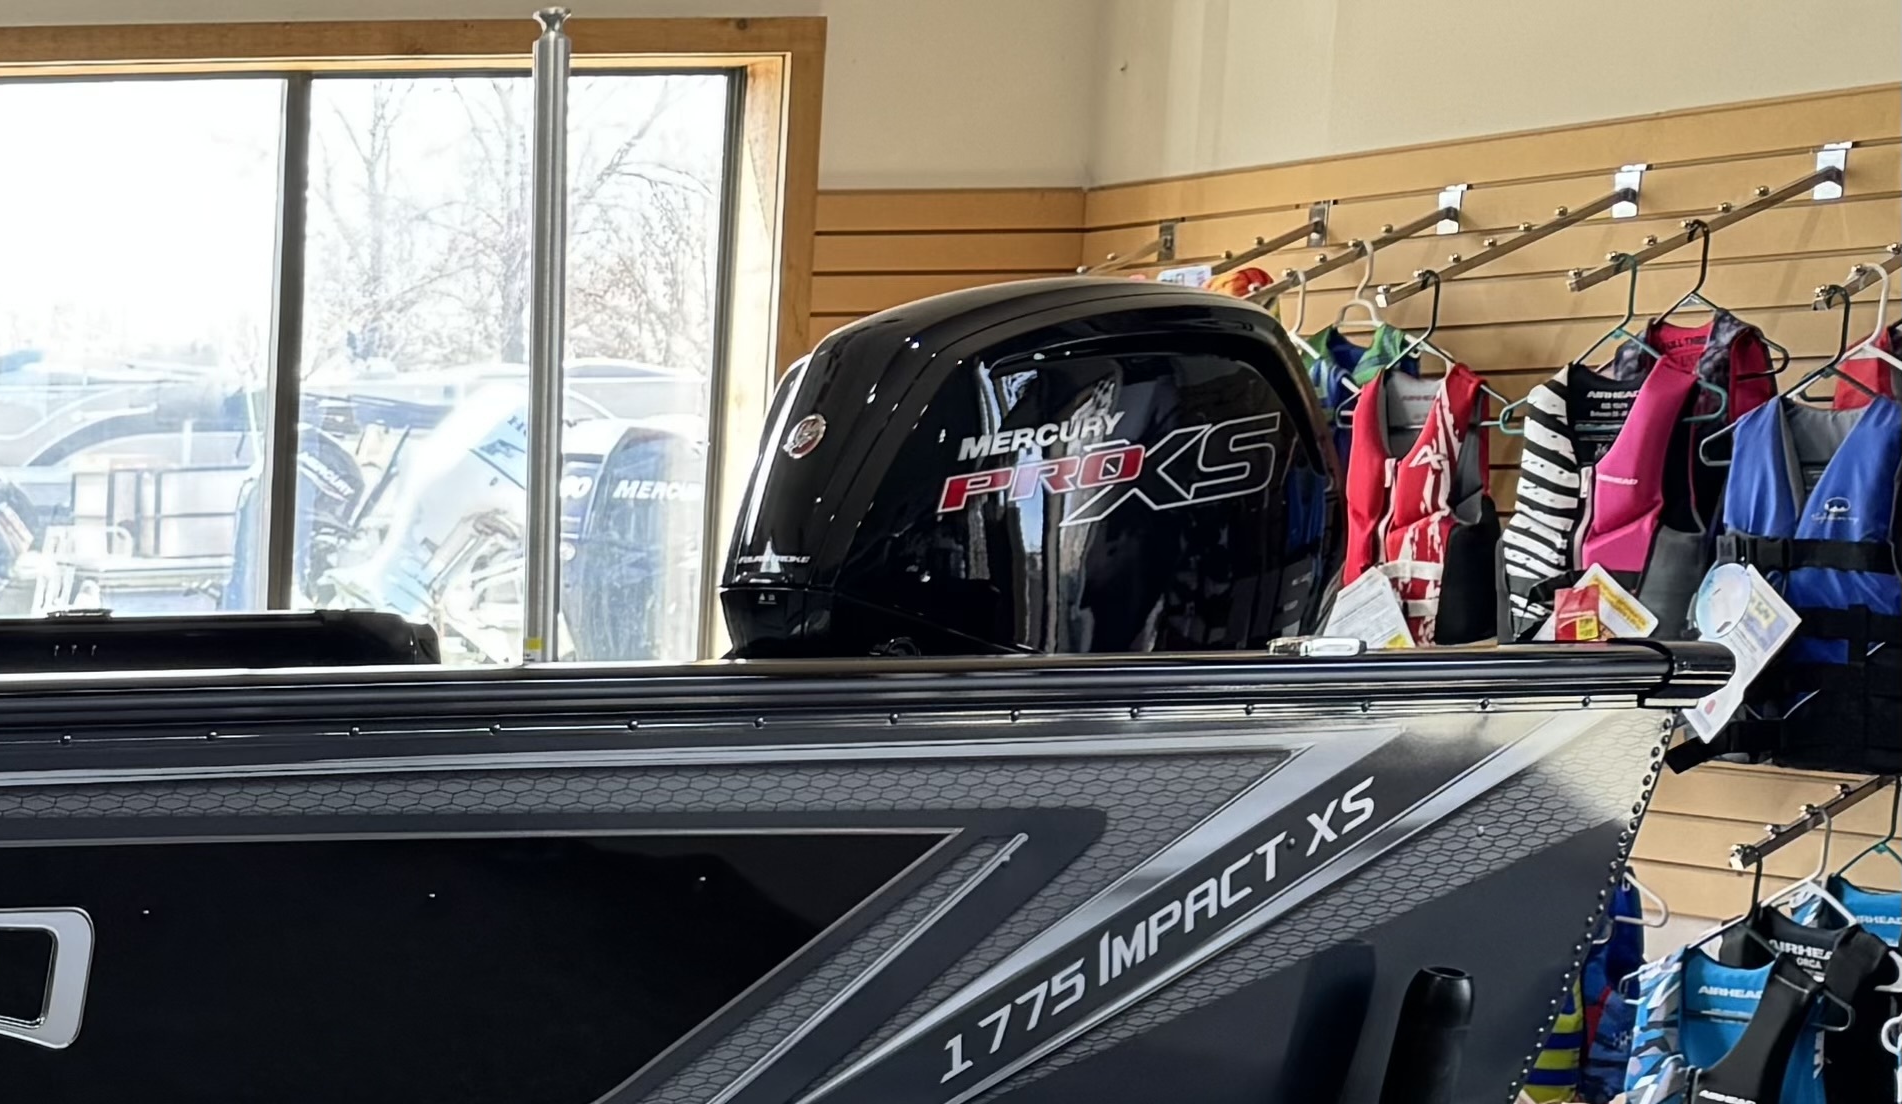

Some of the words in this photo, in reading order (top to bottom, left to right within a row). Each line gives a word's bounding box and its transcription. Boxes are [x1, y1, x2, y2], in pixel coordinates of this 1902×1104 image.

[957, 412, 1125, 461] MERCURY
[937, 444, 1146, 513] PRO
[939, 957, 1085, 1084] 1775
[1099, 830, 1287, 986] IMPACT
[1306, 776, 1376, 858] XS
[1768, 939, 1833, 960] AIRHEA
